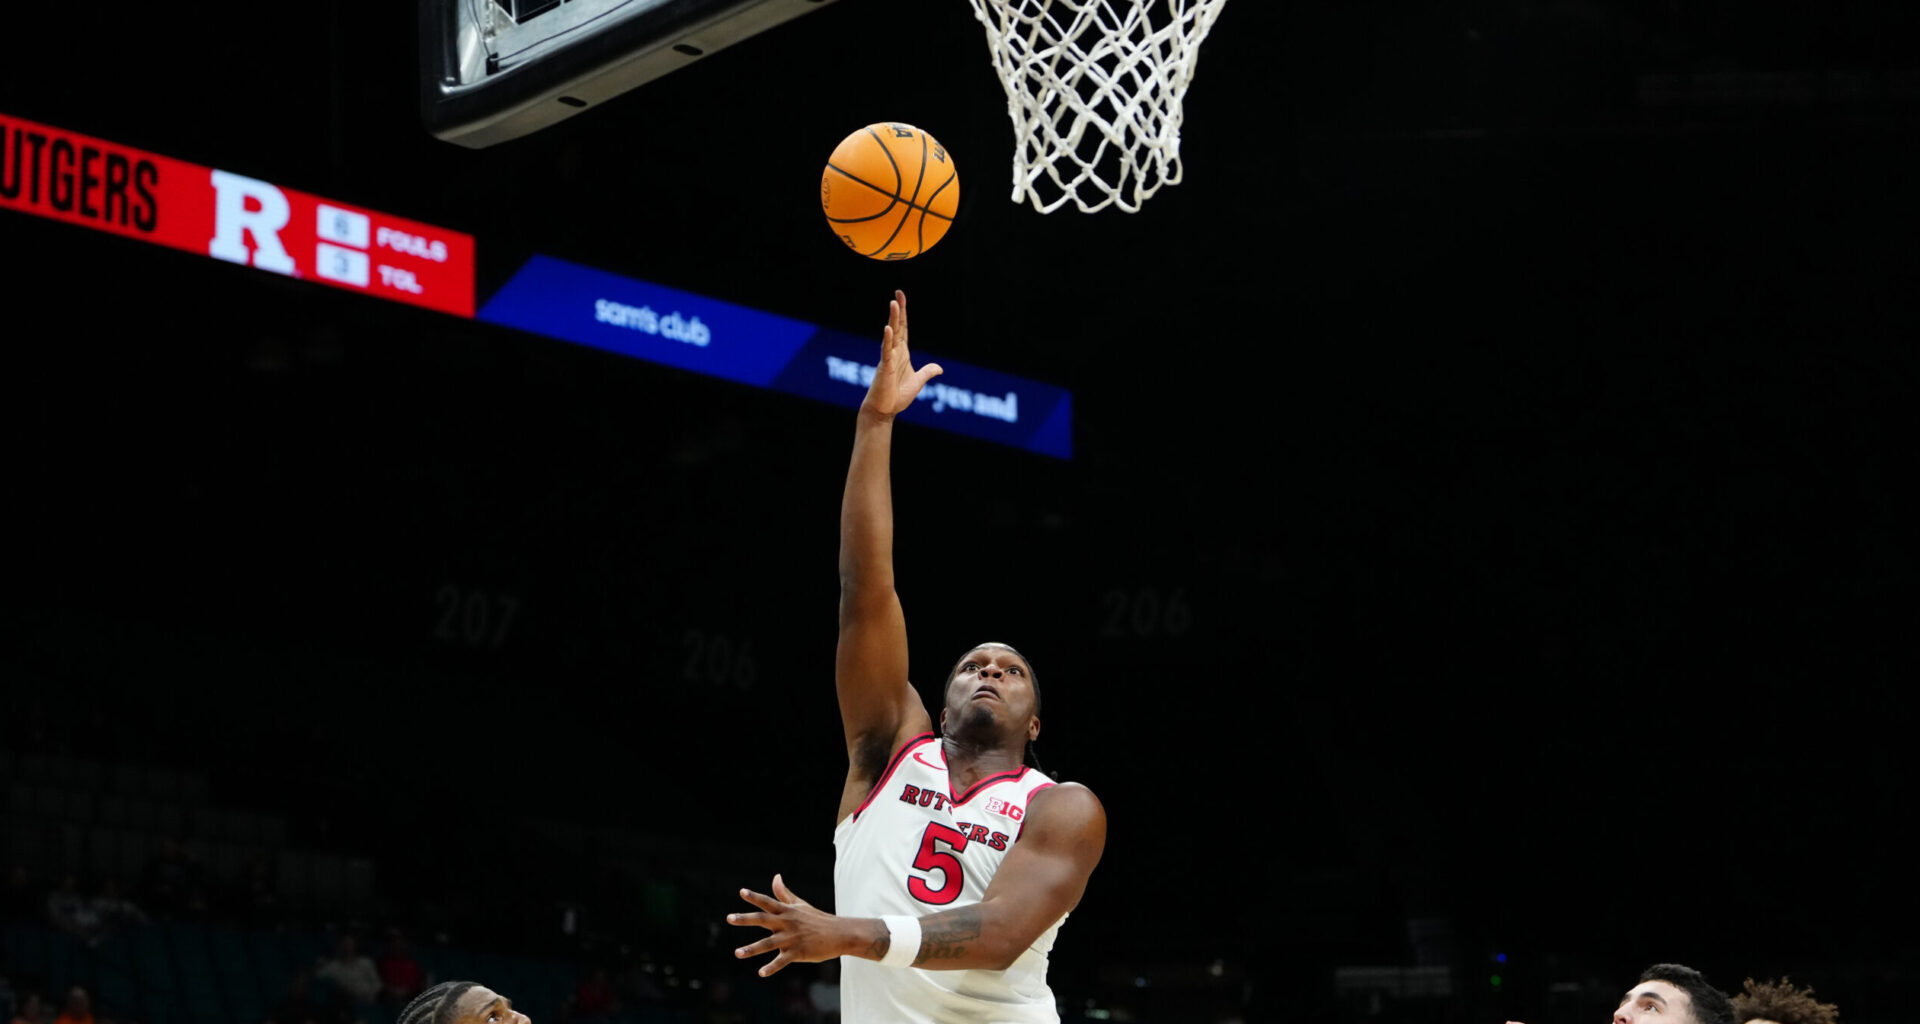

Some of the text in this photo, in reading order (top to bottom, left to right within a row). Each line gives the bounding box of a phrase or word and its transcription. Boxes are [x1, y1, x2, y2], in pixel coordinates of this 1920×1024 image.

[0, 126, 158, 232] UTGERS
[209, 168, 295, 275] R
[377, 226, 447, 262] FOULS
[660, 310, 711, 347] club
[825, 356, 859, 385] THE
[973, 391, 1018, 423] and
[432, 585, 519, 648] 207
[1099, 585, 1190, 638] 206
[682, 629, 757, 691] 206
[900, 784, 1009, 852] RUTERS
[907, 821, 969, 905] 5
